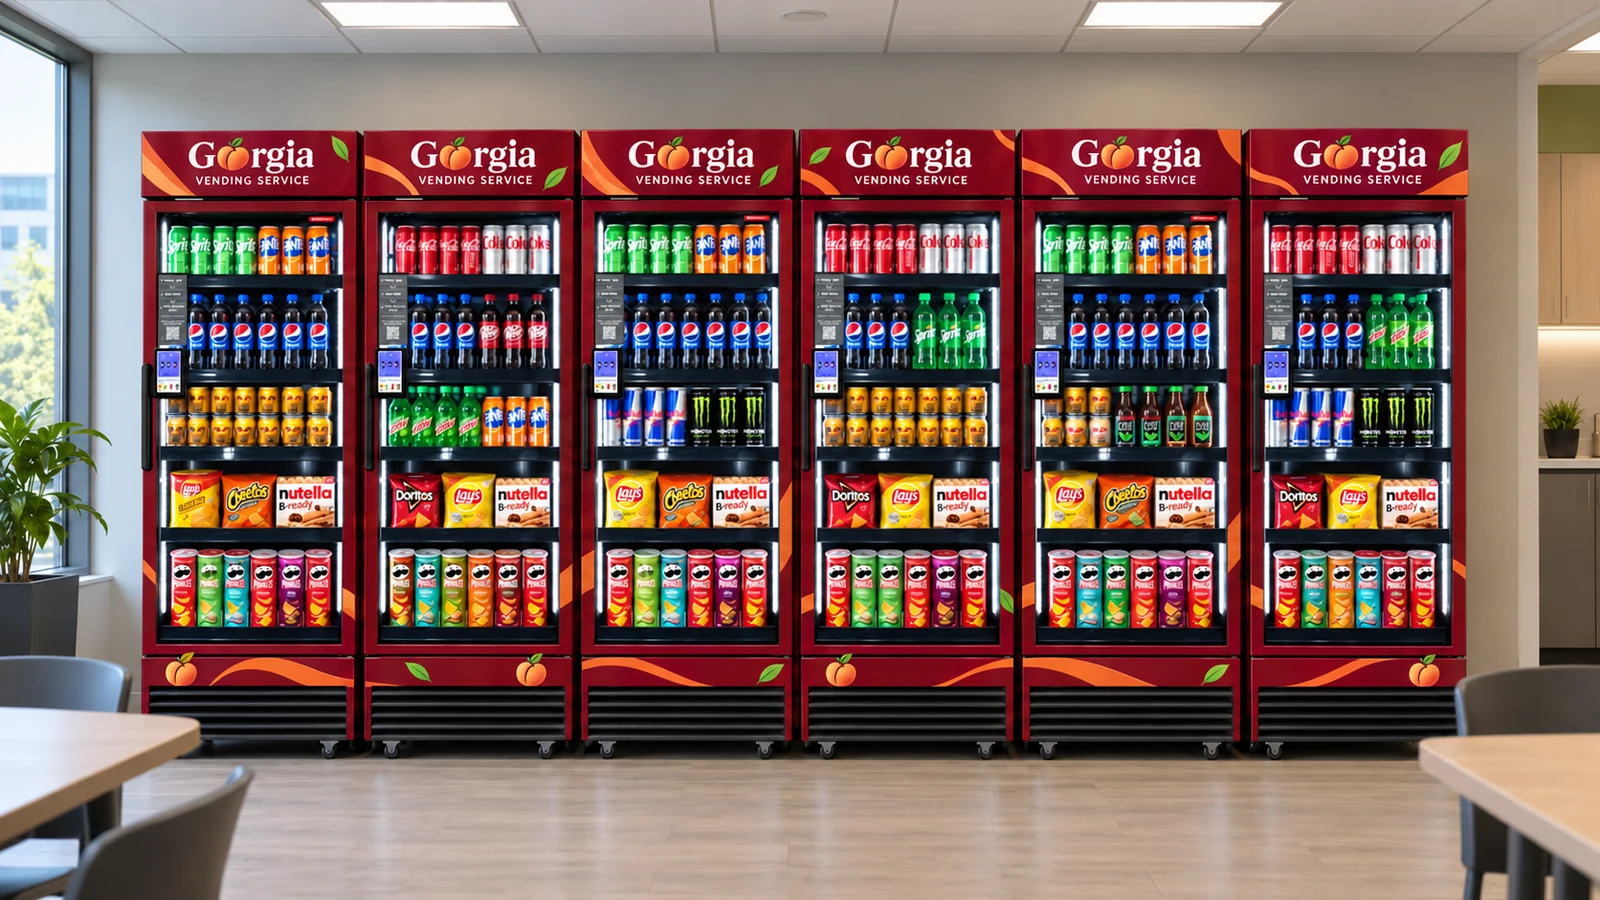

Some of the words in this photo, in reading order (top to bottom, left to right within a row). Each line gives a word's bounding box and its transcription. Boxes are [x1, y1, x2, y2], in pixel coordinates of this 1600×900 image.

[196, 176, 252, 185] VENDING
[257, 176, 309, 185] SERVICE
[419, 176, 475, 185] VENDING
[480, 176, 533, 185] SERVICE
[636, 176, 693, 185] VENDING
[698, 176, 751, 185] SERVICE
[854, 176, 911, 185] VENDING
[915, 176, 968, 185] SERVICE
[1084, 175, 1140, 185] VENDING
[1145, 175, 1196, 185] SERVICE
[1303, 175, 1362, 185] VENDING
[1367, 175, 1422, 185] SERVICE
[227, 483, 269, 511] Cheetos
[279, 486, 332, 499] nutella
[396, 490, 433, 502] Doritos
[498, 487, 547, 500] nutella
[664, 484, 705, 511] Cheetos
[716, 486, 767, 499] nutella
[832, 490, 870, 502] Doritos
[937, 488, 987, 500] nutella
[1159, 487, 1212, 500] nutella
[1280, 490, 1318, 503] Doritos
[1386, 488, 1436, 501] nutella
[279, 501, 313, 511] B-ready
[498, 502, 529, 511] B-ready
[716, 501, 749, 511] B-ready
[1159, 501, 1193, 511] B-ready
[1386, 502, 1417, 512] B-ready
